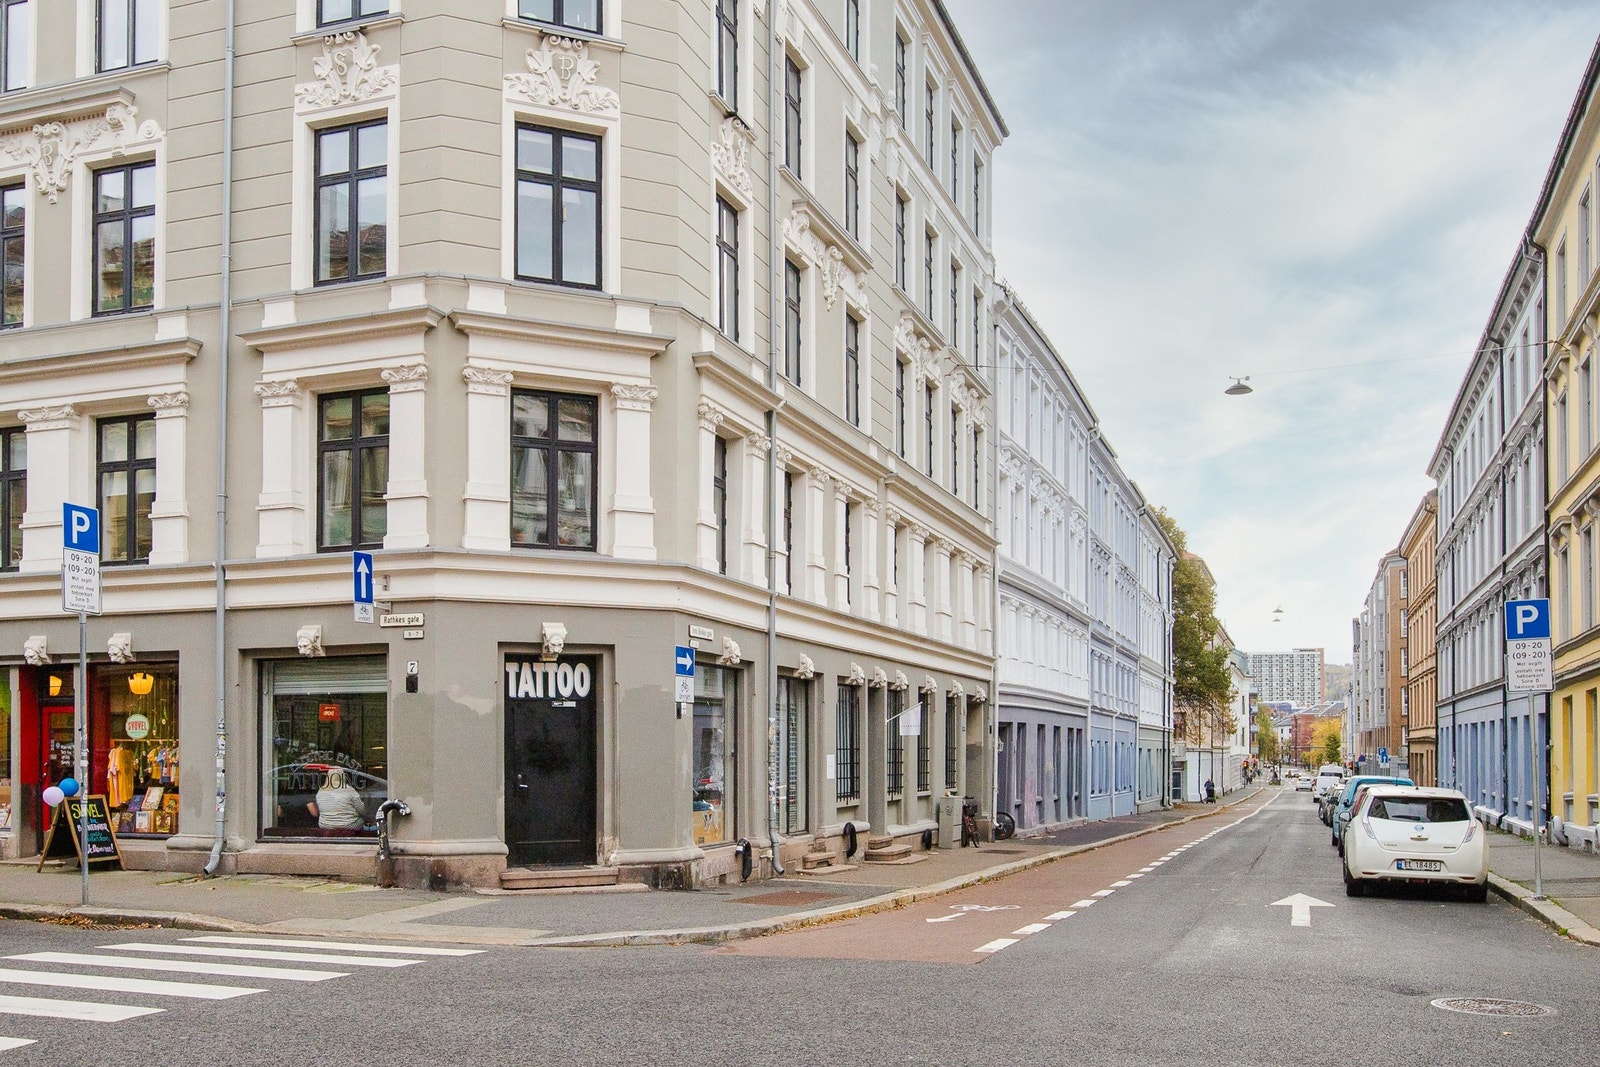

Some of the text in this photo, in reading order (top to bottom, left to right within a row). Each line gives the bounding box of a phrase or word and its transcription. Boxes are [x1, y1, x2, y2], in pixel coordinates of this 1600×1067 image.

[71, 509, 91, 544] P
[383, 615, 420, 625] Rathkes gate
[1516, 604, 1539, 635] P
[409, 662, 416, 673] 7
[505, 661, 591, 698] TATTOO
[287, 771, 367, 790] TATTOOING
[71, 803, 104, 819] SVEL
[1415, 861, 1438, 869] 18485
